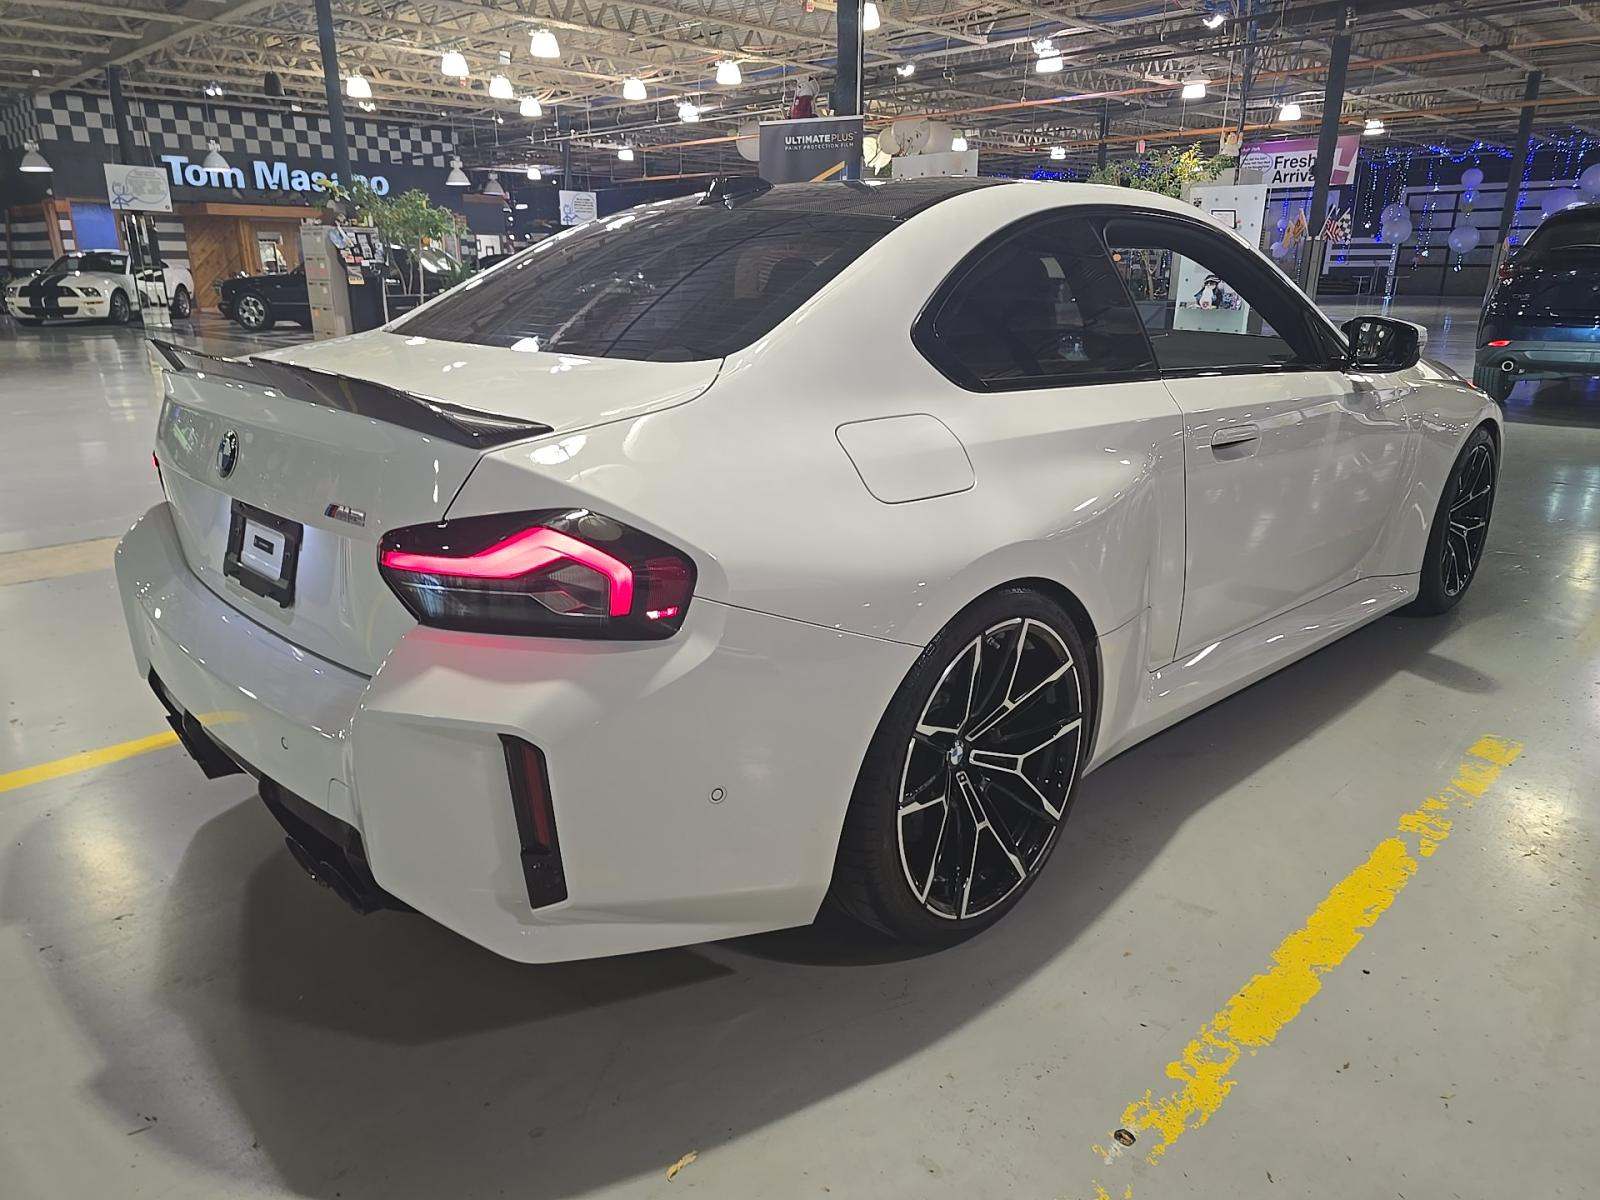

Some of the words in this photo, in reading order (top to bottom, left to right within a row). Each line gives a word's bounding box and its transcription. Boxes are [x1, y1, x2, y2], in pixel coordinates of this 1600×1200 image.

[1274, 153, 1316, 170] Fresh
[161, 155, 246, 189] Tom
[1272, 168, 1316, 184] Arriva
